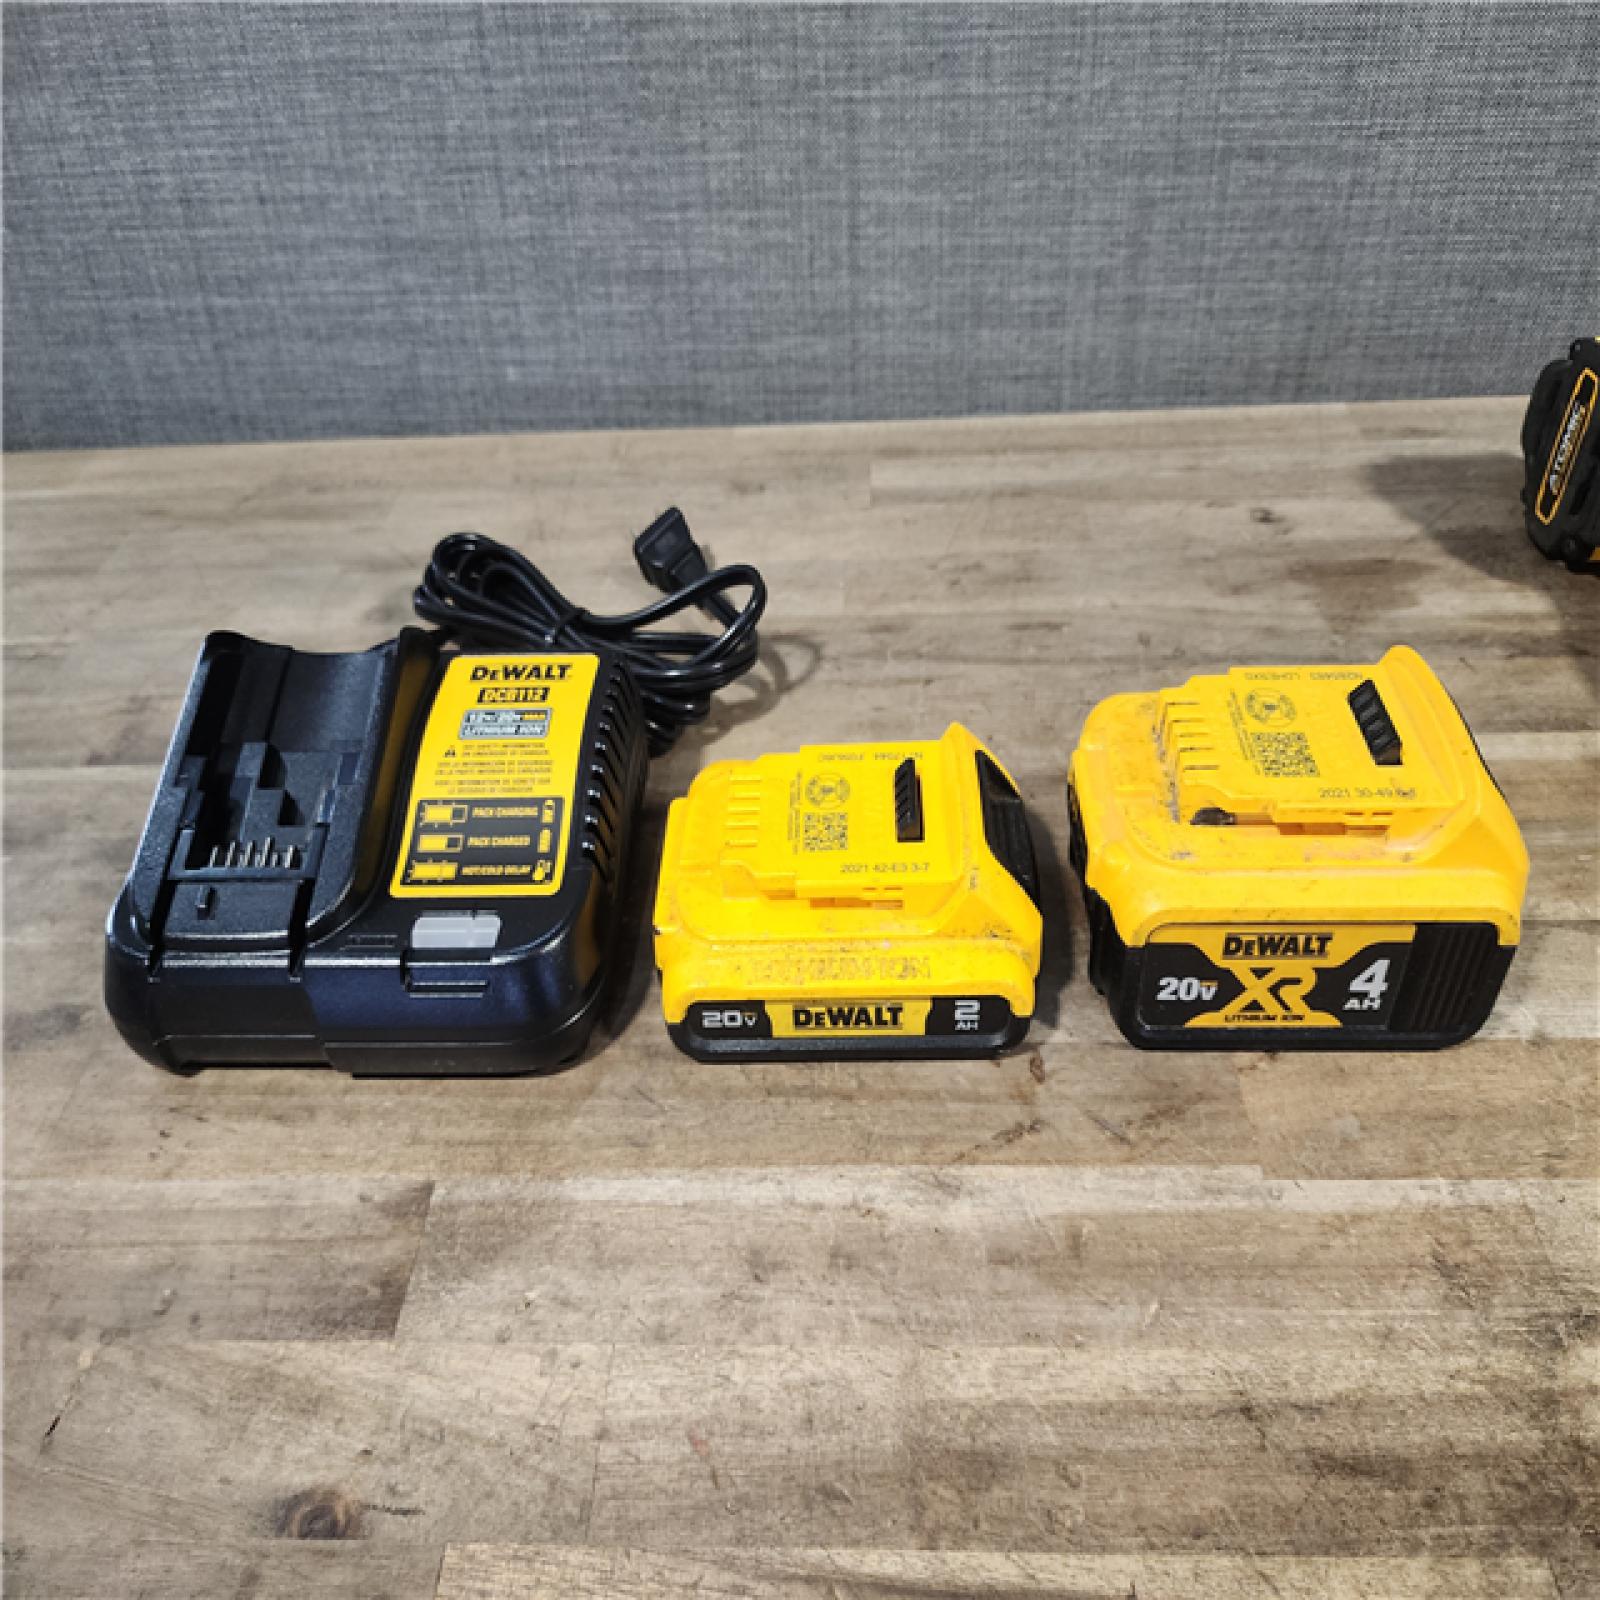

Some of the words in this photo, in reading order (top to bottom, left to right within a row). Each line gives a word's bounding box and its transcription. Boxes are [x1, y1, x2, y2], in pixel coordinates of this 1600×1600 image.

[1223, 935, 1333, 956] DEWALT
[1349, 959, 1391, 999] 4
[794, 1006, 903, 1027] DEWALT
[954, 1000, 981, 1021] 2
